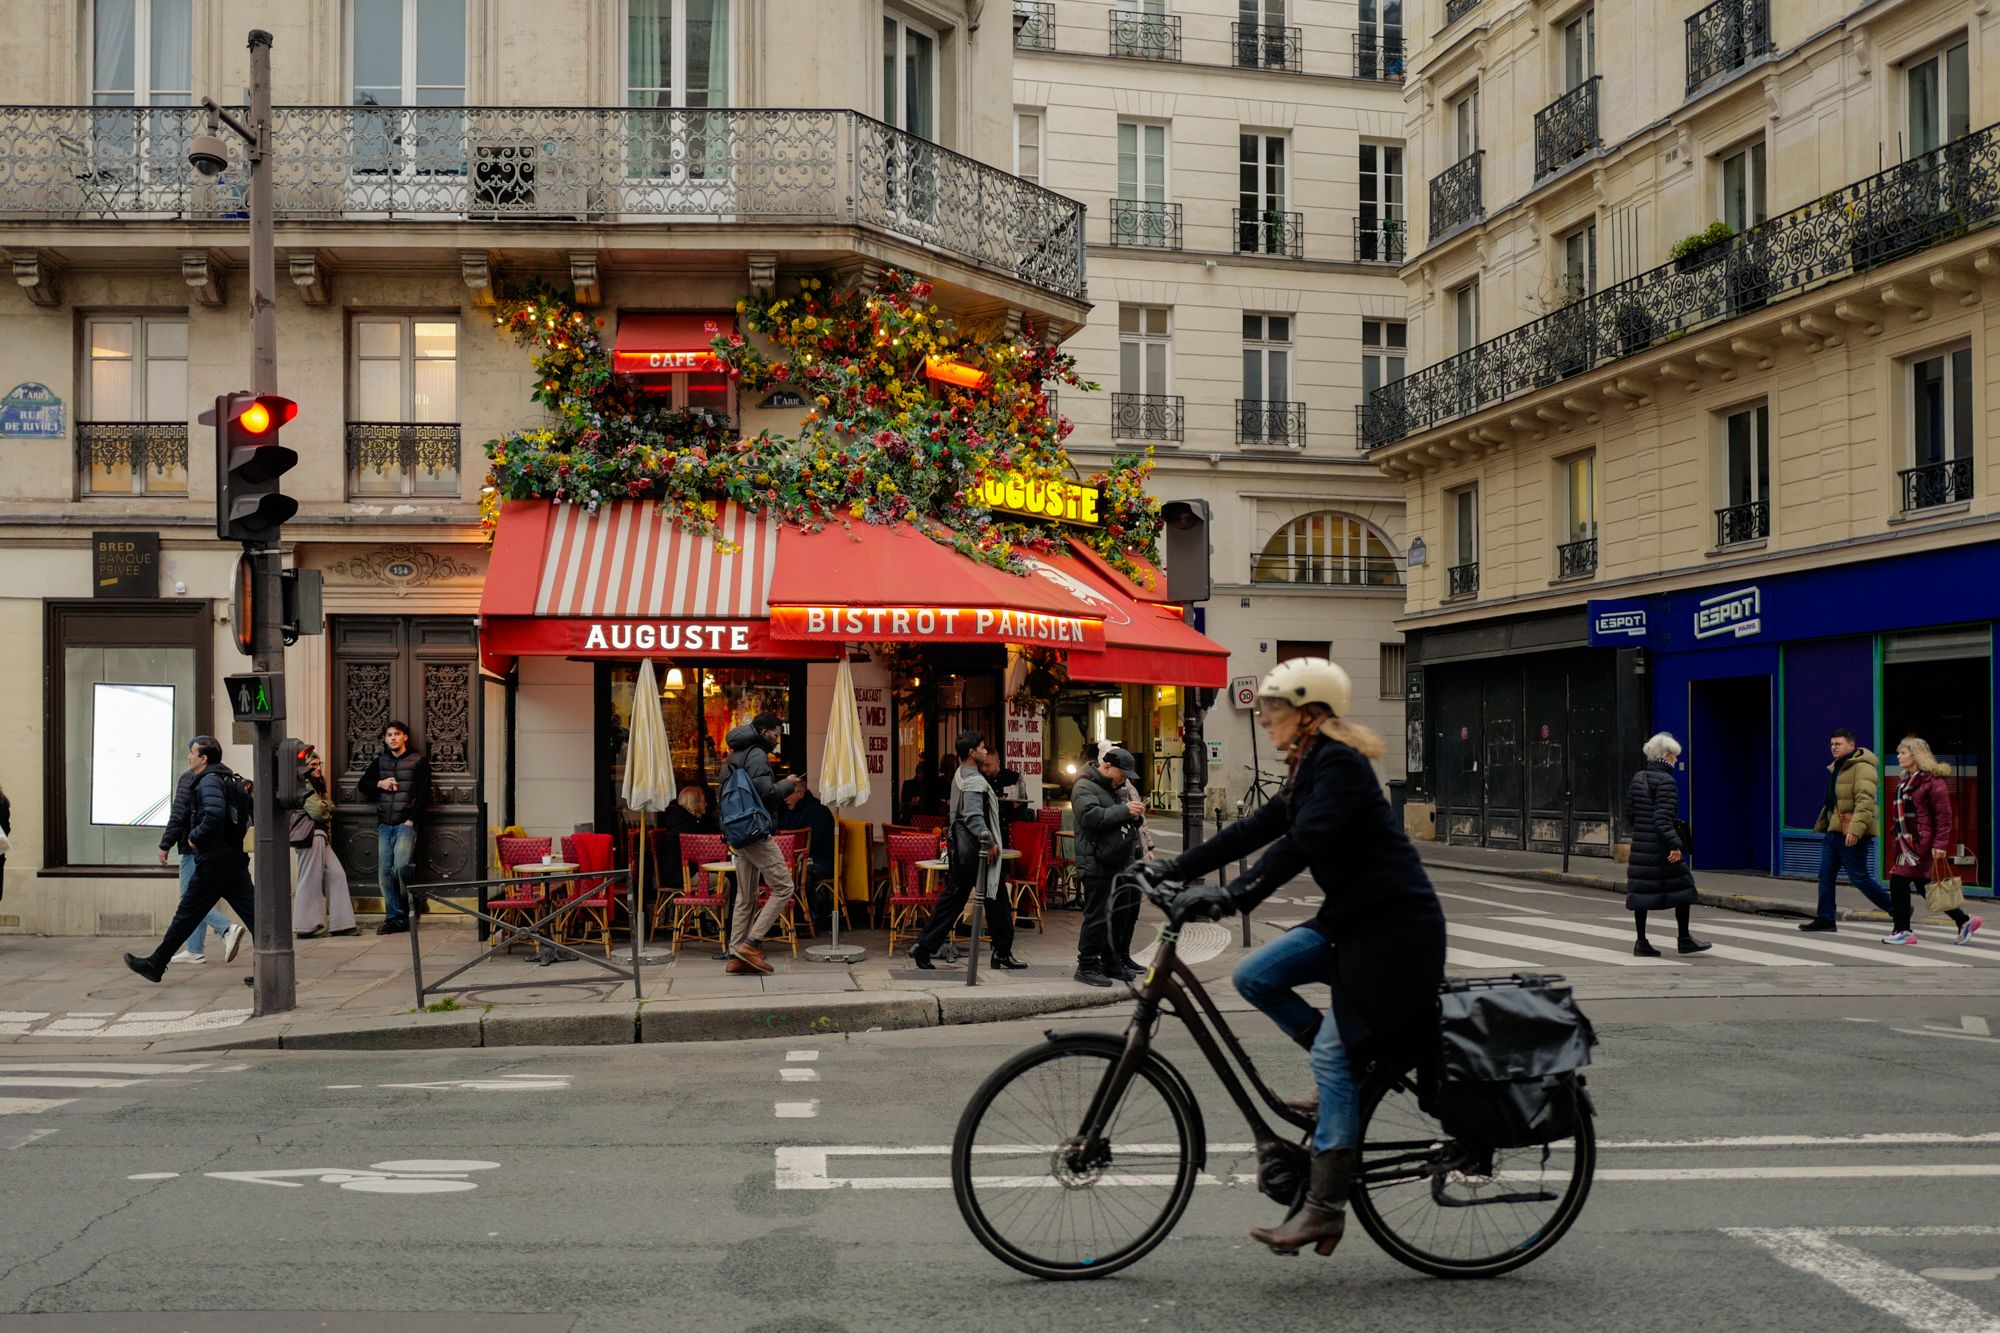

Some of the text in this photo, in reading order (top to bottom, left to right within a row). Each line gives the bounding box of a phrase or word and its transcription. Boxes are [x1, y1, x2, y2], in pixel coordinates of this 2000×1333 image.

[20, 410, 43, 419] RUE
[5, 422, 58, 431] DE RIVOLI
[99, 542, 135, 552] BRED
[99, 553, 152, 564] BANQUE
[807, 608, 1084, 642] BISTROT PARISIEN
[584, 624, 749, 651] AUGUSTE
[866, 706, 886, 726] WINES
[869, 737, 887, 751] BEERS
